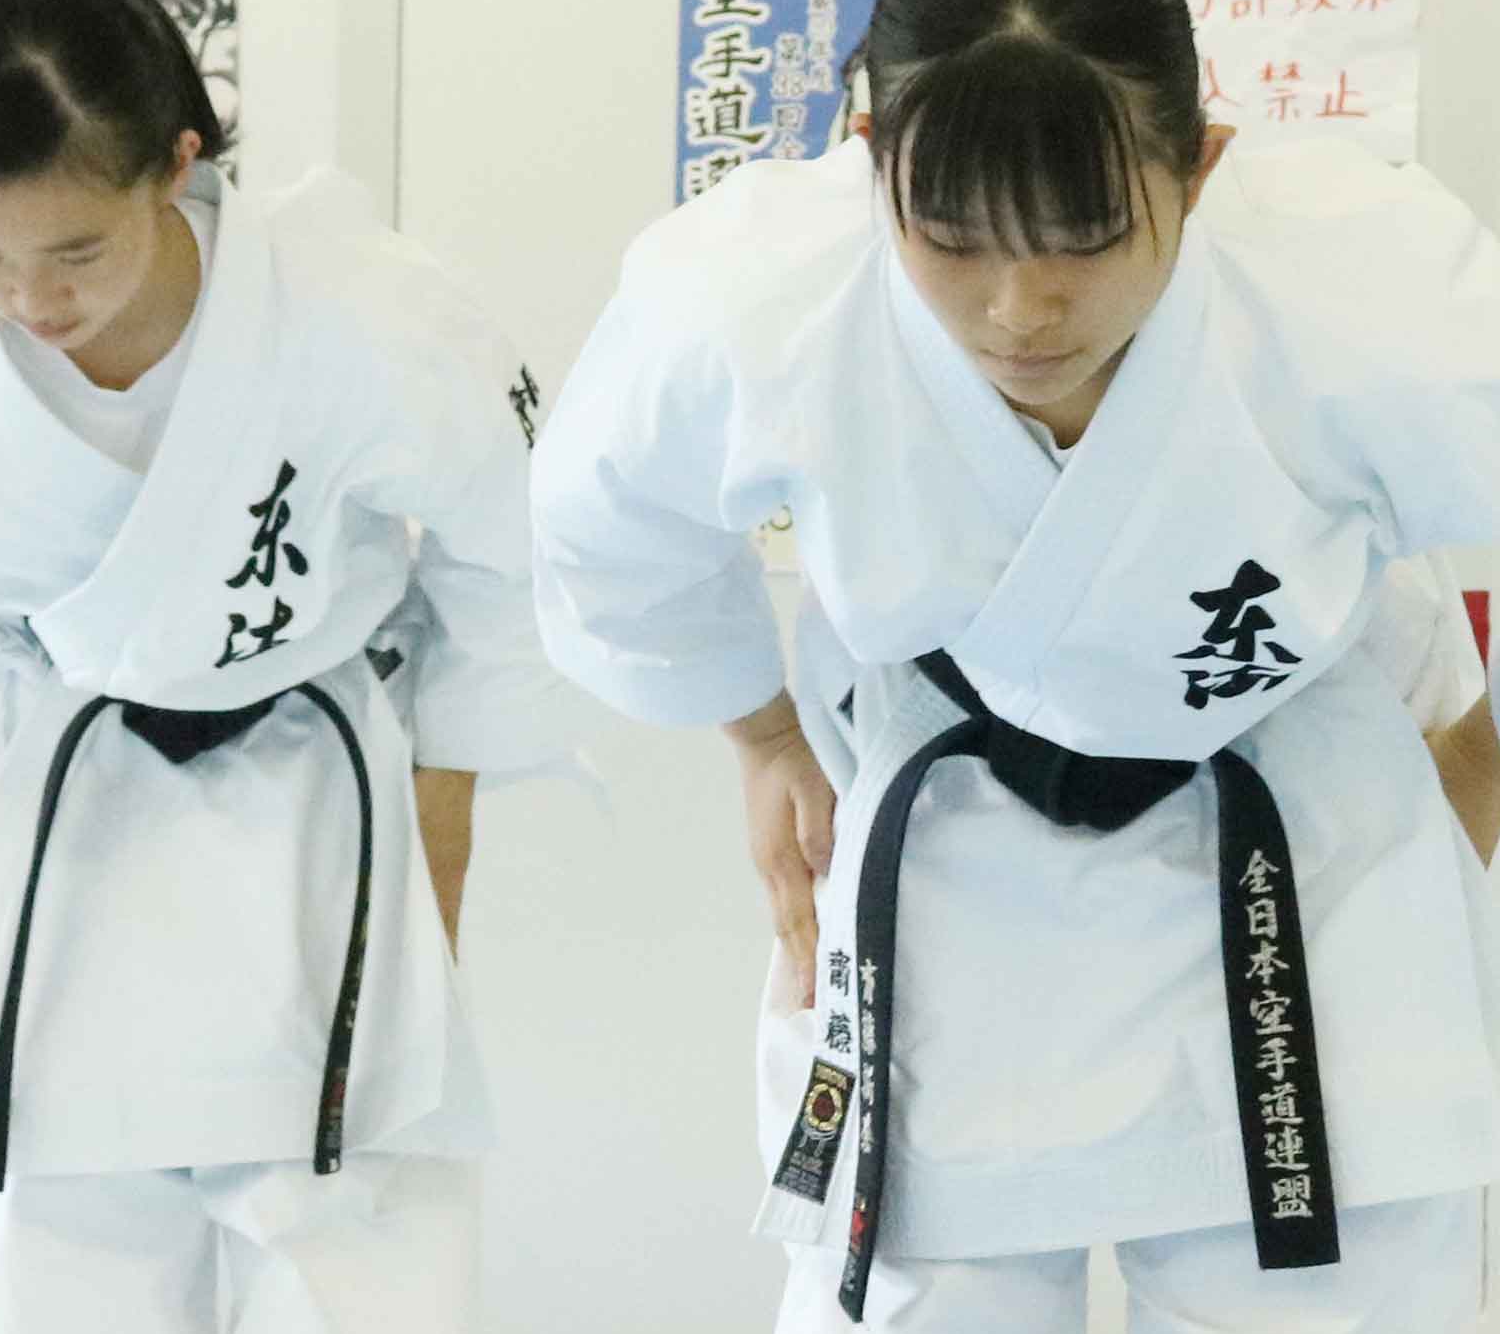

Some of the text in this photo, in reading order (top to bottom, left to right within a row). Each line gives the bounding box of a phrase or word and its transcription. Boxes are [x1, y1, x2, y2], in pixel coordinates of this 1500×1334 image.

[1238, 850, 1313, 1220] 全日本空手道連盟
